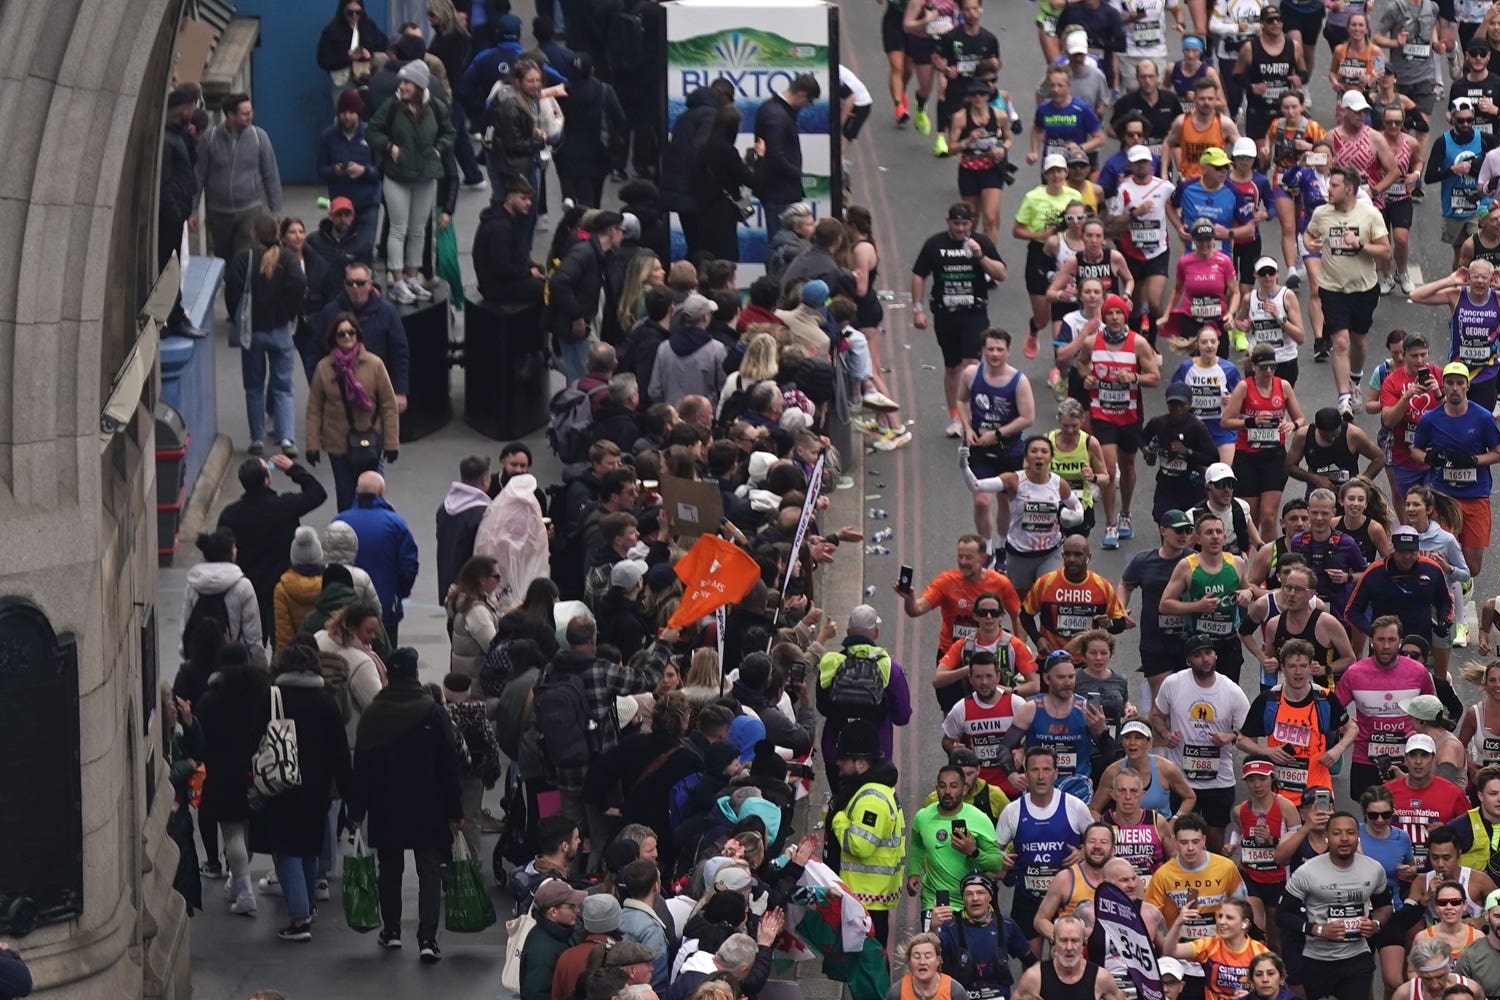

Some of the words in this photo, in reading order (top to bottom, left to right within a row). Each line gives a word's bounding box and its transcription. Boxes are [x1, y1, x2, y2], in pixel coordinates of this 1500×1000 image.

[681, 69, 815, 98] BUXTO
[1079, 264, 1110, 278] ROBYN
[1193, 273, 1216, 281] JULIE
[1458, 308, 1497, 319] Pancreatic
[1458, 315, 1484, 324] Cancer
[1465, 327, 1489, 337] GEORGE
[1192, 376, 1219, 384] VICKY
[1205, 584, 1225, 594] DAN
[1055, 589, 1092, 603] CHRIS
[970, 721, 1001, 732] GAVIN
[1373, 720, 1405, 731] Lloyd
[1276, 722, 1308, 746] BEN
[1191, 760, 1212, 770] 7688
[1114, 830, 1151, 844] WEENS
[1022, 842, 1064, 852] NEWRY
[1137, 845, 1154, 855] LIVES
[1034, 854, 1050, 862] AC
[1173, 878, 1222, 889] PADDY
[1186, 928, 1208, 938] 9742
[1121, 939, 1152, 971] 3:45
